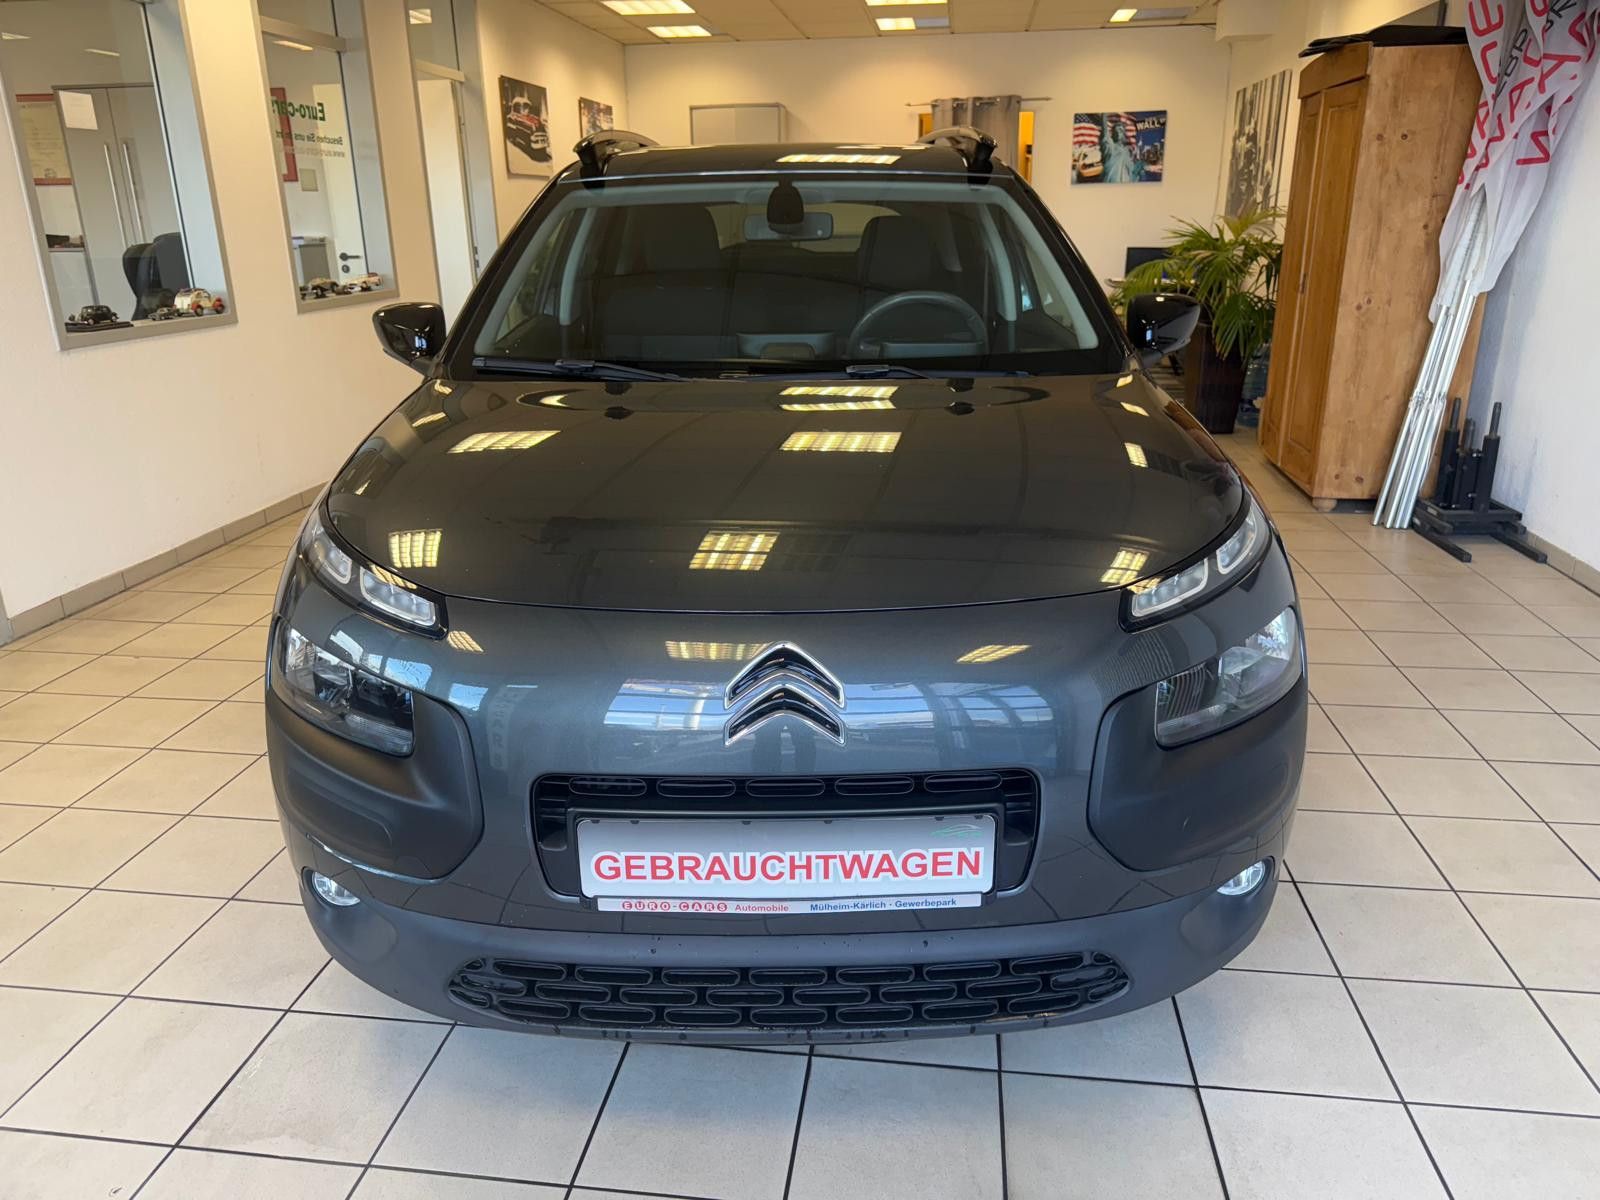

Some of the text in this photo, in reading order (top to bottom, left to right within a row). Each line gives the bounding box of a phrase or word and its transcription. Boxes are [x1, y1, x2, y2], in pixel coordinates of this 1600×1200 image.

[593, 850, 981, 882] GEBRAUCHTWAGEN
[622, 898, 957, 912] EURO-CARS Automobile Mülheim-Kärlich Gewerbepark
